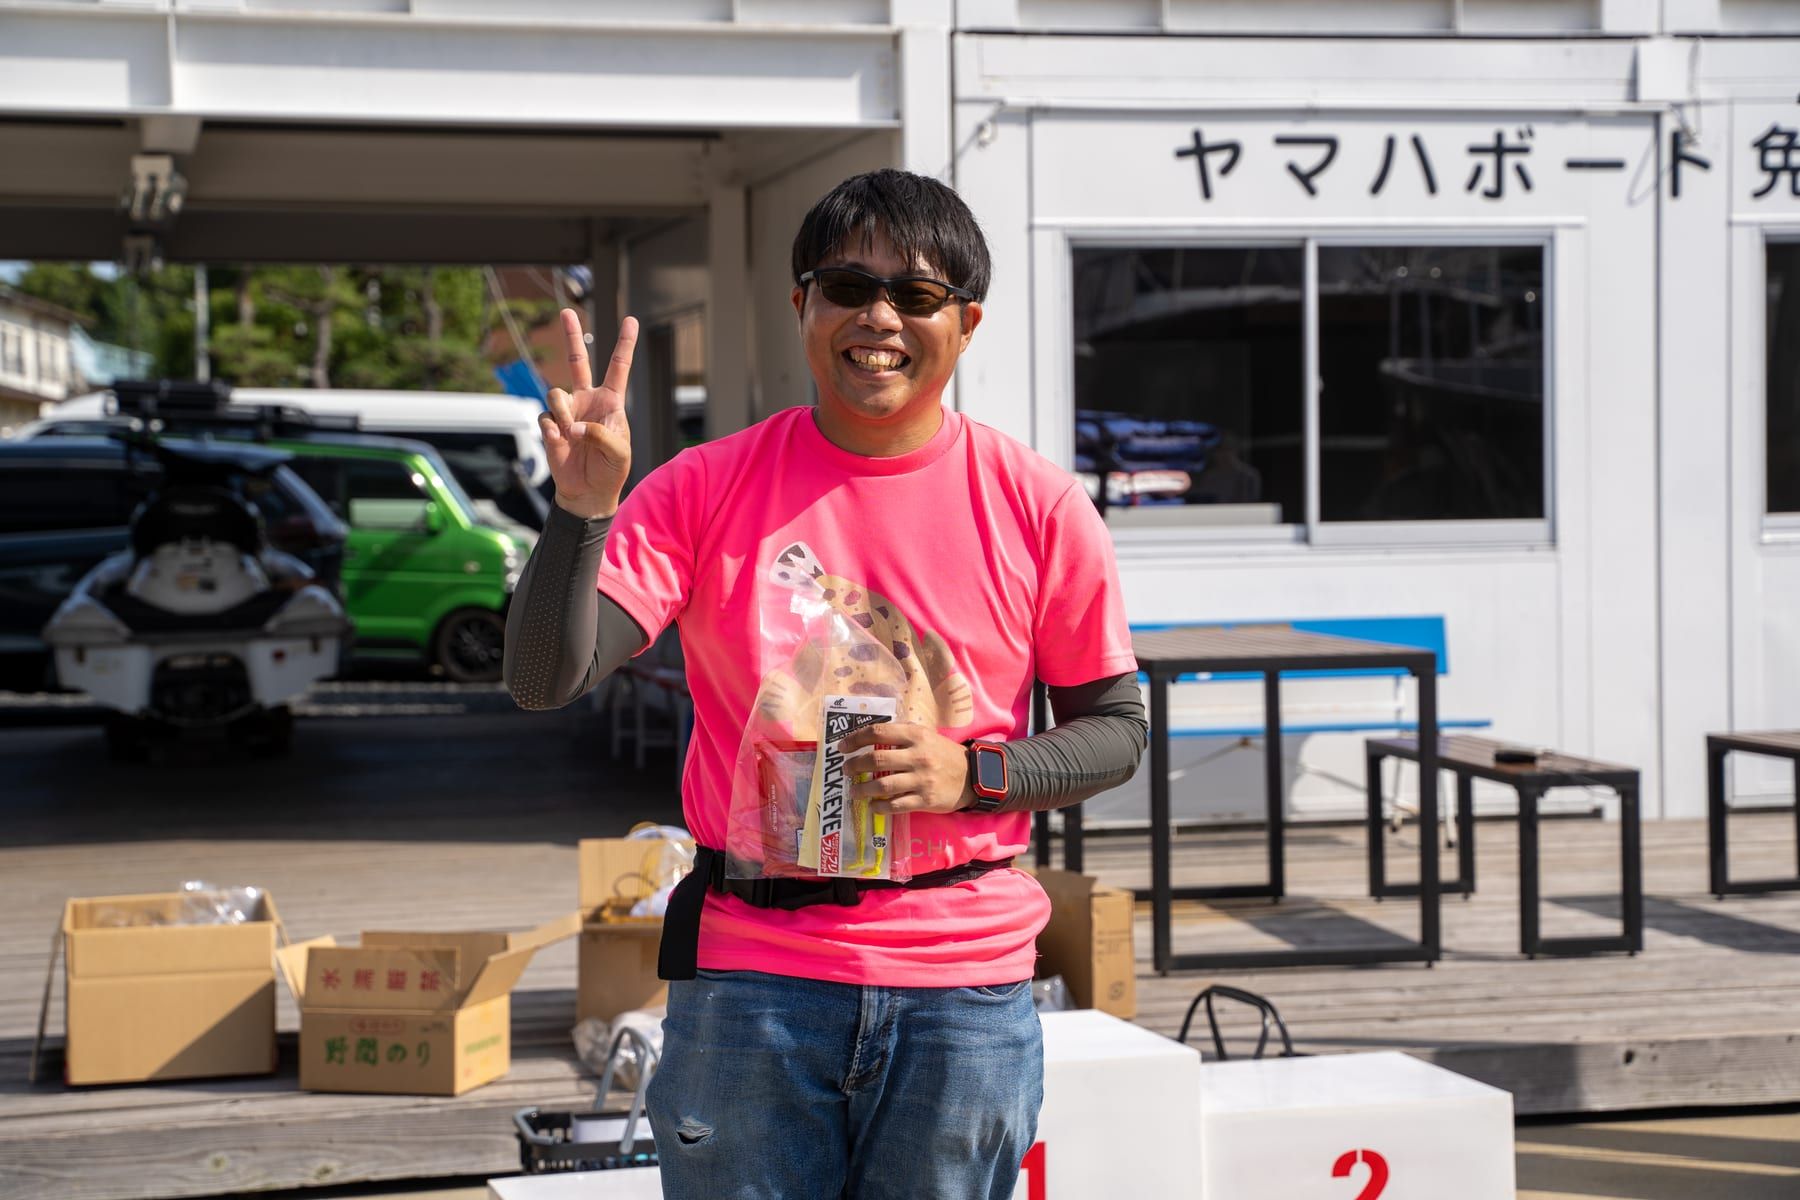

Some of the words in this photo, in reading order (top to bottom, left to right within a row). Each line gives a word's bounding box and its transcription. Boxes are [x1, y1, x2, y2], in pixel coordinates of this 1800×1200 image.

[1175, 126, 1711, 200] ヤマハボート
[1020, 1142, 1046, 1200] 1
[1331, 1149, 1389, 1200] 2
